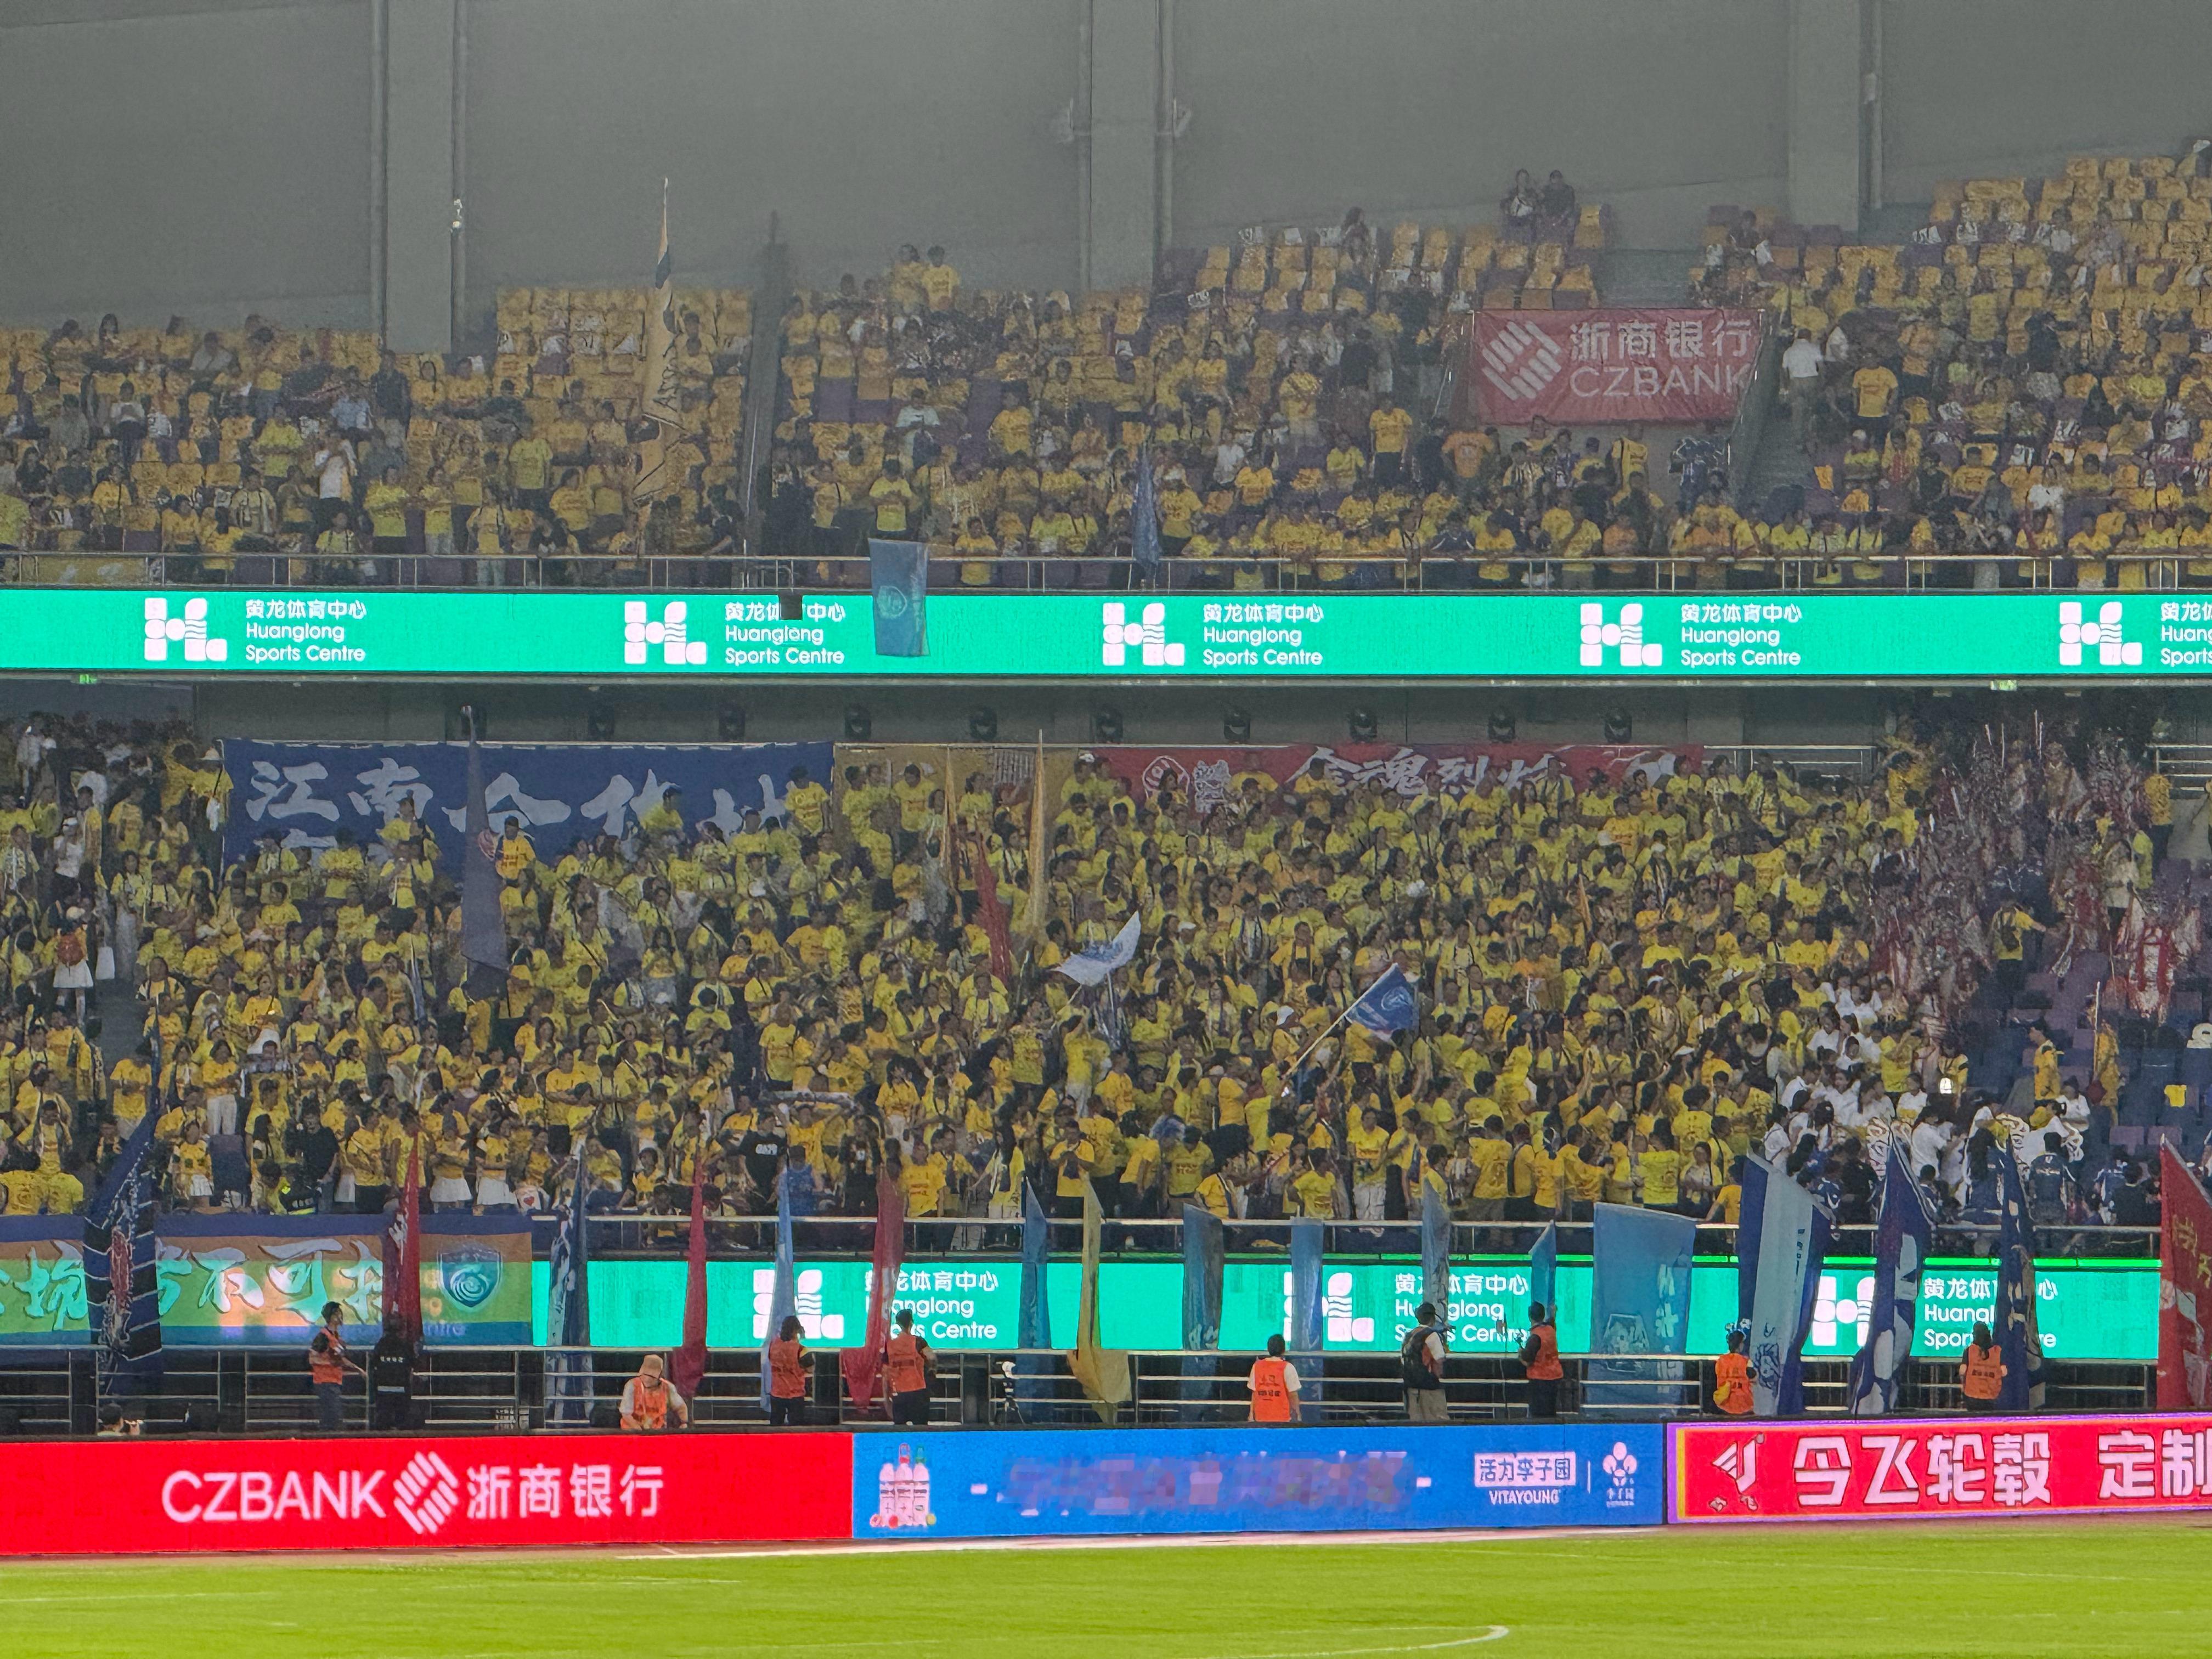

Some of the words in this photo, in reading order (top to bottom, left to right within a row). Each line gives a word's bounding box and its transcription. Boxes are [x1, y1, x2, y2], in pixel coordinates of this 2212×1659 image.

[1570, 319, 1752, 361] 浙商银行
[1570, 363, 1752, 398] CZBANK
[246, 599, 367, 620] 黄龙体育中心
[725, 602, 846, 622] 黄龙体中心
[1203, 602, 1324, 623] 黄龙体育中心
[1681, 603, 1803, 623] 黄龙体育中心
[246, 622, 345, 643] Huanglong
[725, 624, 823, 645] Huanglong
[1204, 626, 1302, 647] Huanglong
[1681, 626, 1780, 647] Huanglong
[246, 644, 301, 664] Sports
[306, 645, 366, 662] Centre
[725, 647, 781, 667] Sports
[785, 647, 845, 664] Centre
[1203, 648, 1259, 668] Sports
[1263, 649, 1323, 665] Centre
[1681, 649, 1736, 668] Sports
[1741, 649, 1801, 665] Centre
[1395, 1272, 1529, 1295] 黄体育中心
[1924, 1277, 2058, 1300] 黄龙体心
[866, 1296, 974, 1318] anglong
[932, 1321, 997, 1339] Centre
[1792, 1432, 2052, 1506] 今飞轮毂
[2097, 1429, 2212, 1499] 定制
[161, 1470, 387, 1523] CZBANK
[466, 1464, 664, 1520] 浙商银行
[1489, 1489, 1559, 1505] VITAYOUNG
